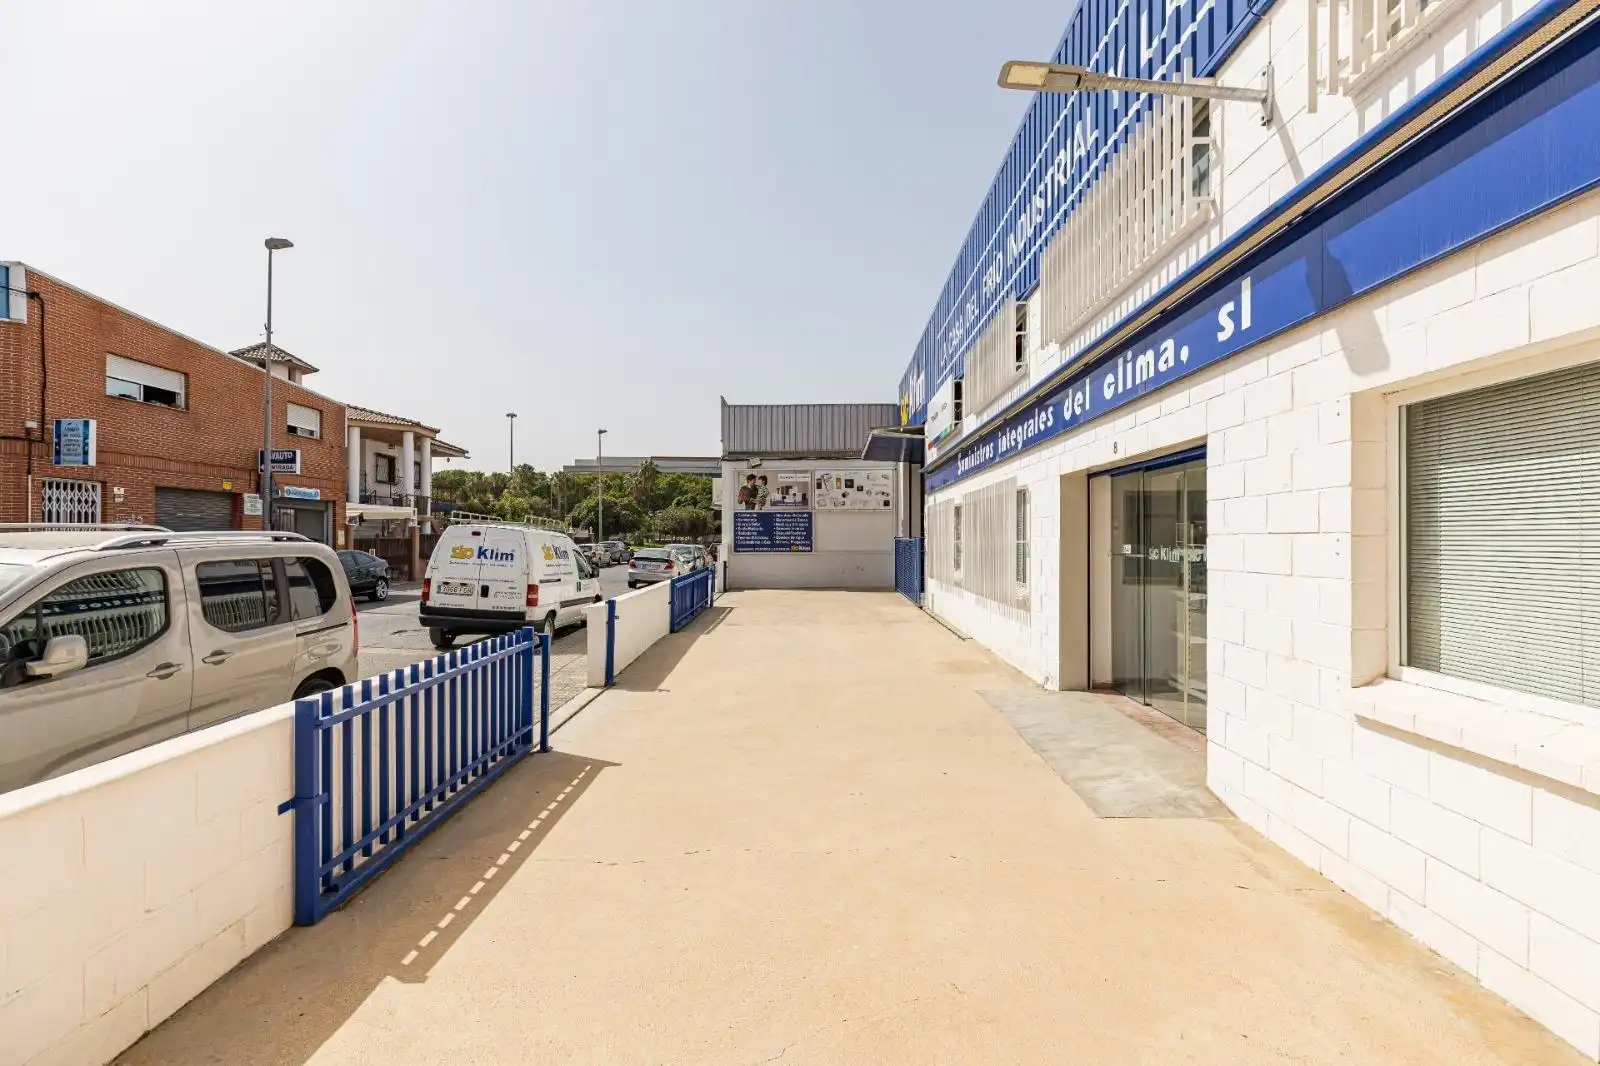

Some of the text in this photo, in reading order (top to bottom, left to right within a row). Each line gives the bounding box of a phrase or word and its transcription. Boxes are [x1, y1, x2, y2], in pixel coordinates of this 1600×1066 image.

[1007, 105, 1099, 268] INDUSTRIAL
[958, 276, 1251, 475] Suministros integrales del clima, sl
[1113, 441, 1118, 454] 8
[477, 545, 514, 561] Klim
